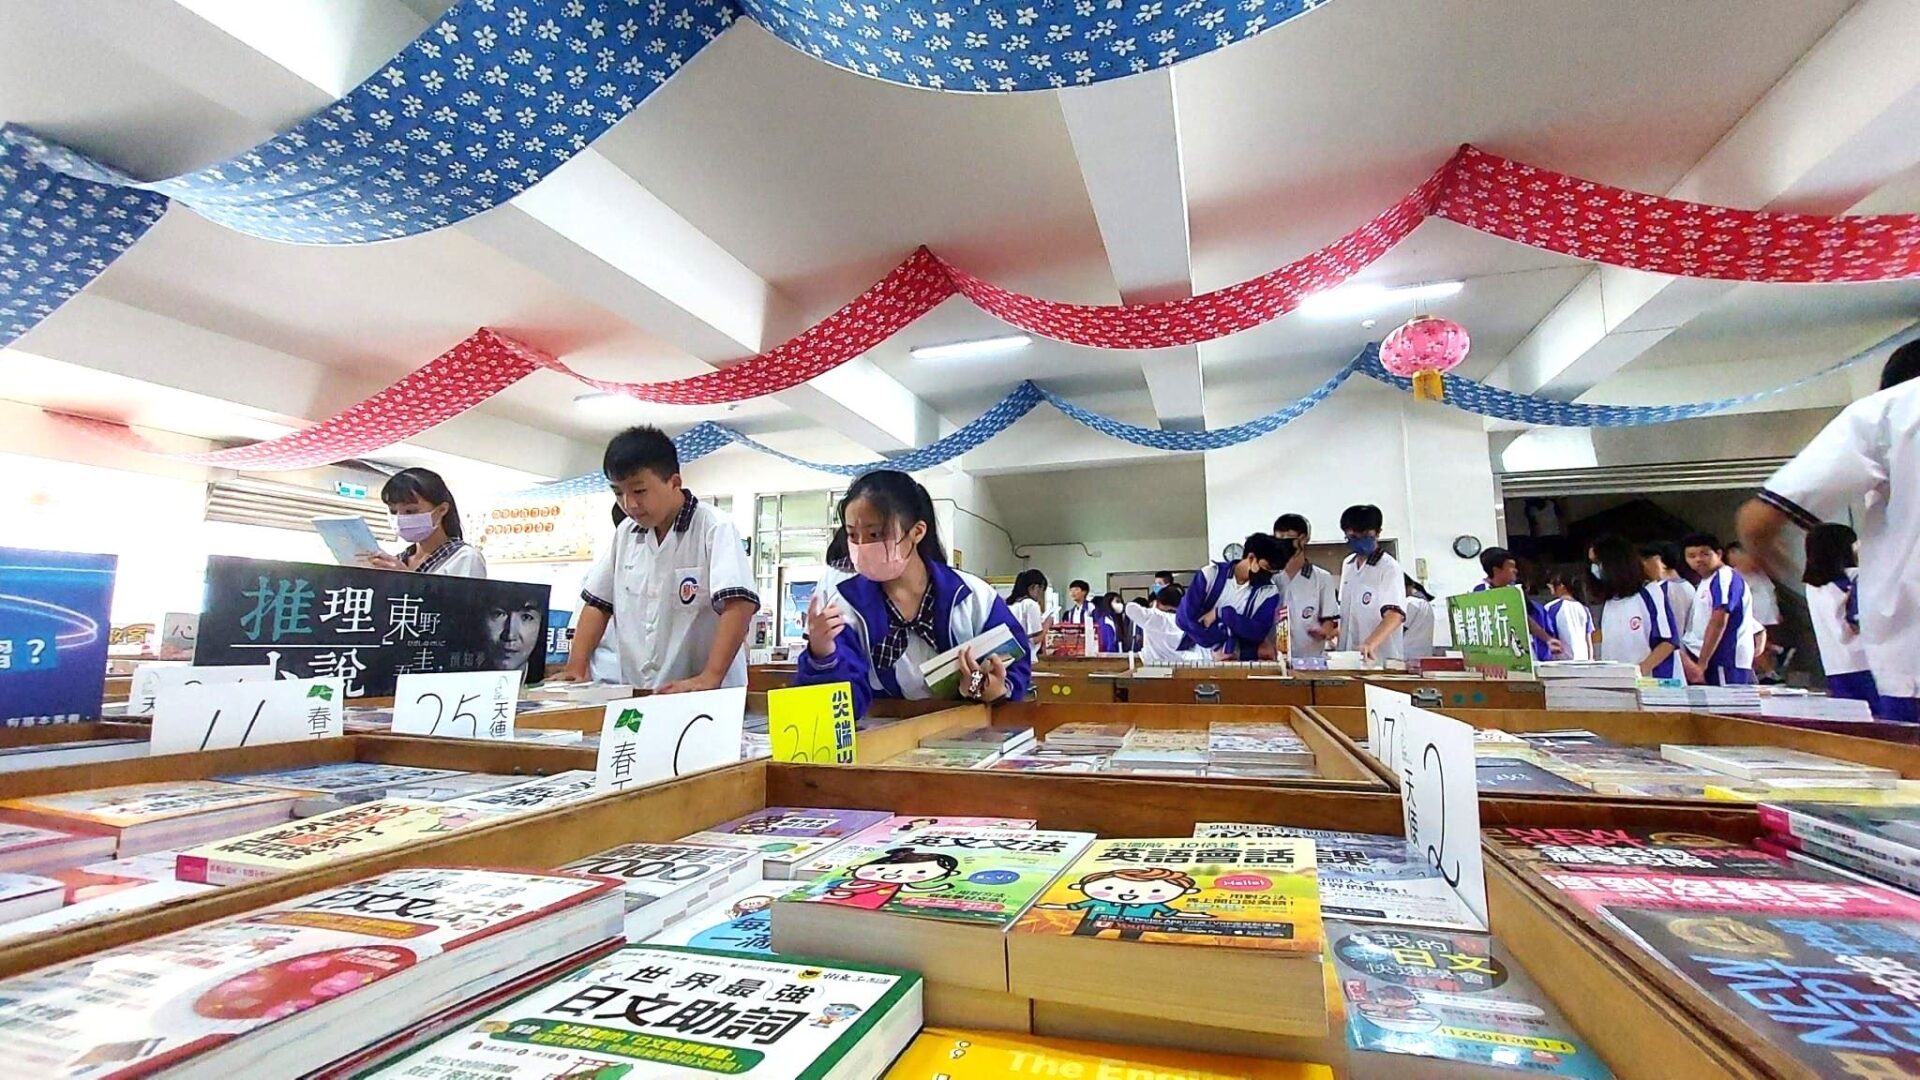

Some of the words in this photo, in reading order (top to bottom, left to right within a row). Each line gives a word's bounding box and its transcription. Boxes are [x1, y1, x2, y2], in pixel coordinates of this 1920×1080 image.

[240, 576, 375, 642] 推理
[896, 834, 1069, 853] 英文文法
[1095, 848, 1295, 864] 英語會話
[1393, 949, 1498, 975] 日文
[625, 965, 816, 1004] 世界最強
[543, 985, 811, 1044] 日文助詞
[1007, 1049, 1084, 1078] The
